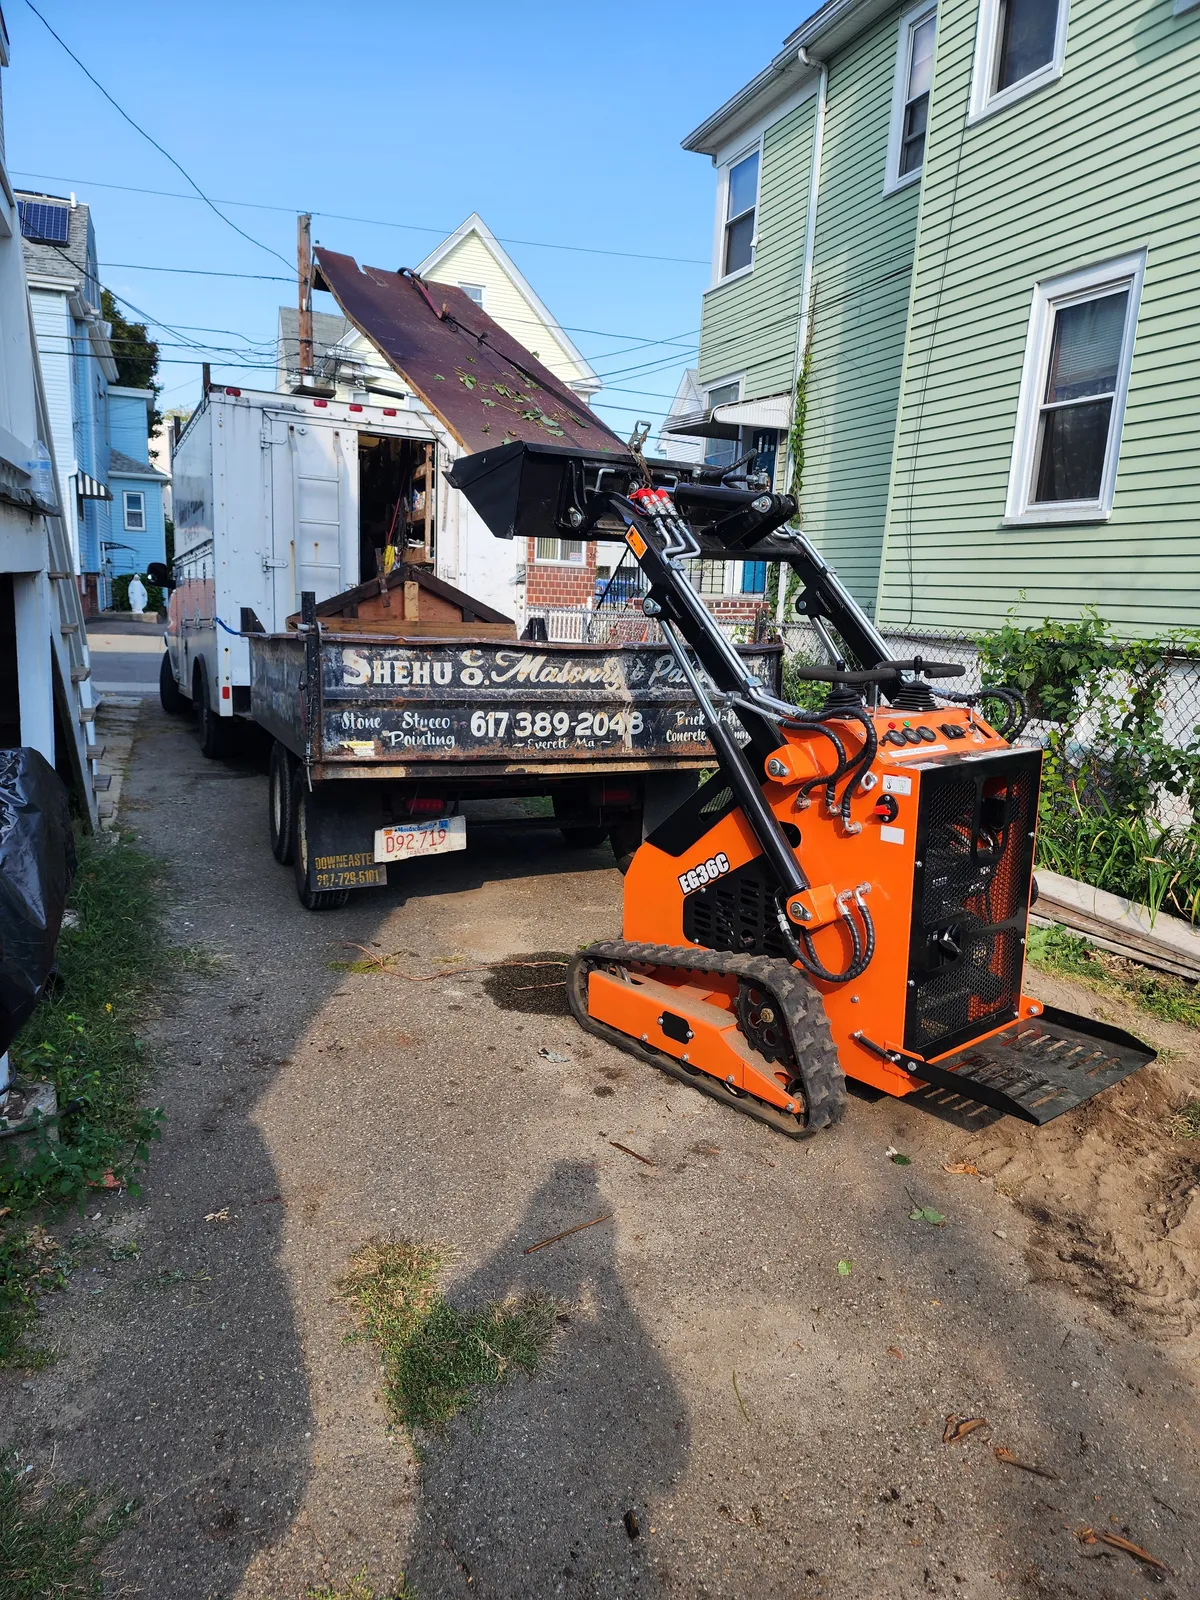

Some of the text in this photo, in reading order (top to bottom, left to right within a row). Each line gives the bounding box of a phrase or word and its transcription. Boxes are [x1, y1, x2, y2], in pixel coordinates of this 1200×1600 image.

[342, 649, 454, 685] SHEHU
[490, 650, 624, 691] Masonry
[341, 711, 451, 730] Stone Stucco
[470, 711, 644, 738] 617 389-2048
[676, 711, 706, 727] Brick
[386, 730, 456, 750] Pointing
[527, 738, 569, 750] Everett
[666, 729, 707, 744] Concrete
[678, 853, 730, 894] EG36C
